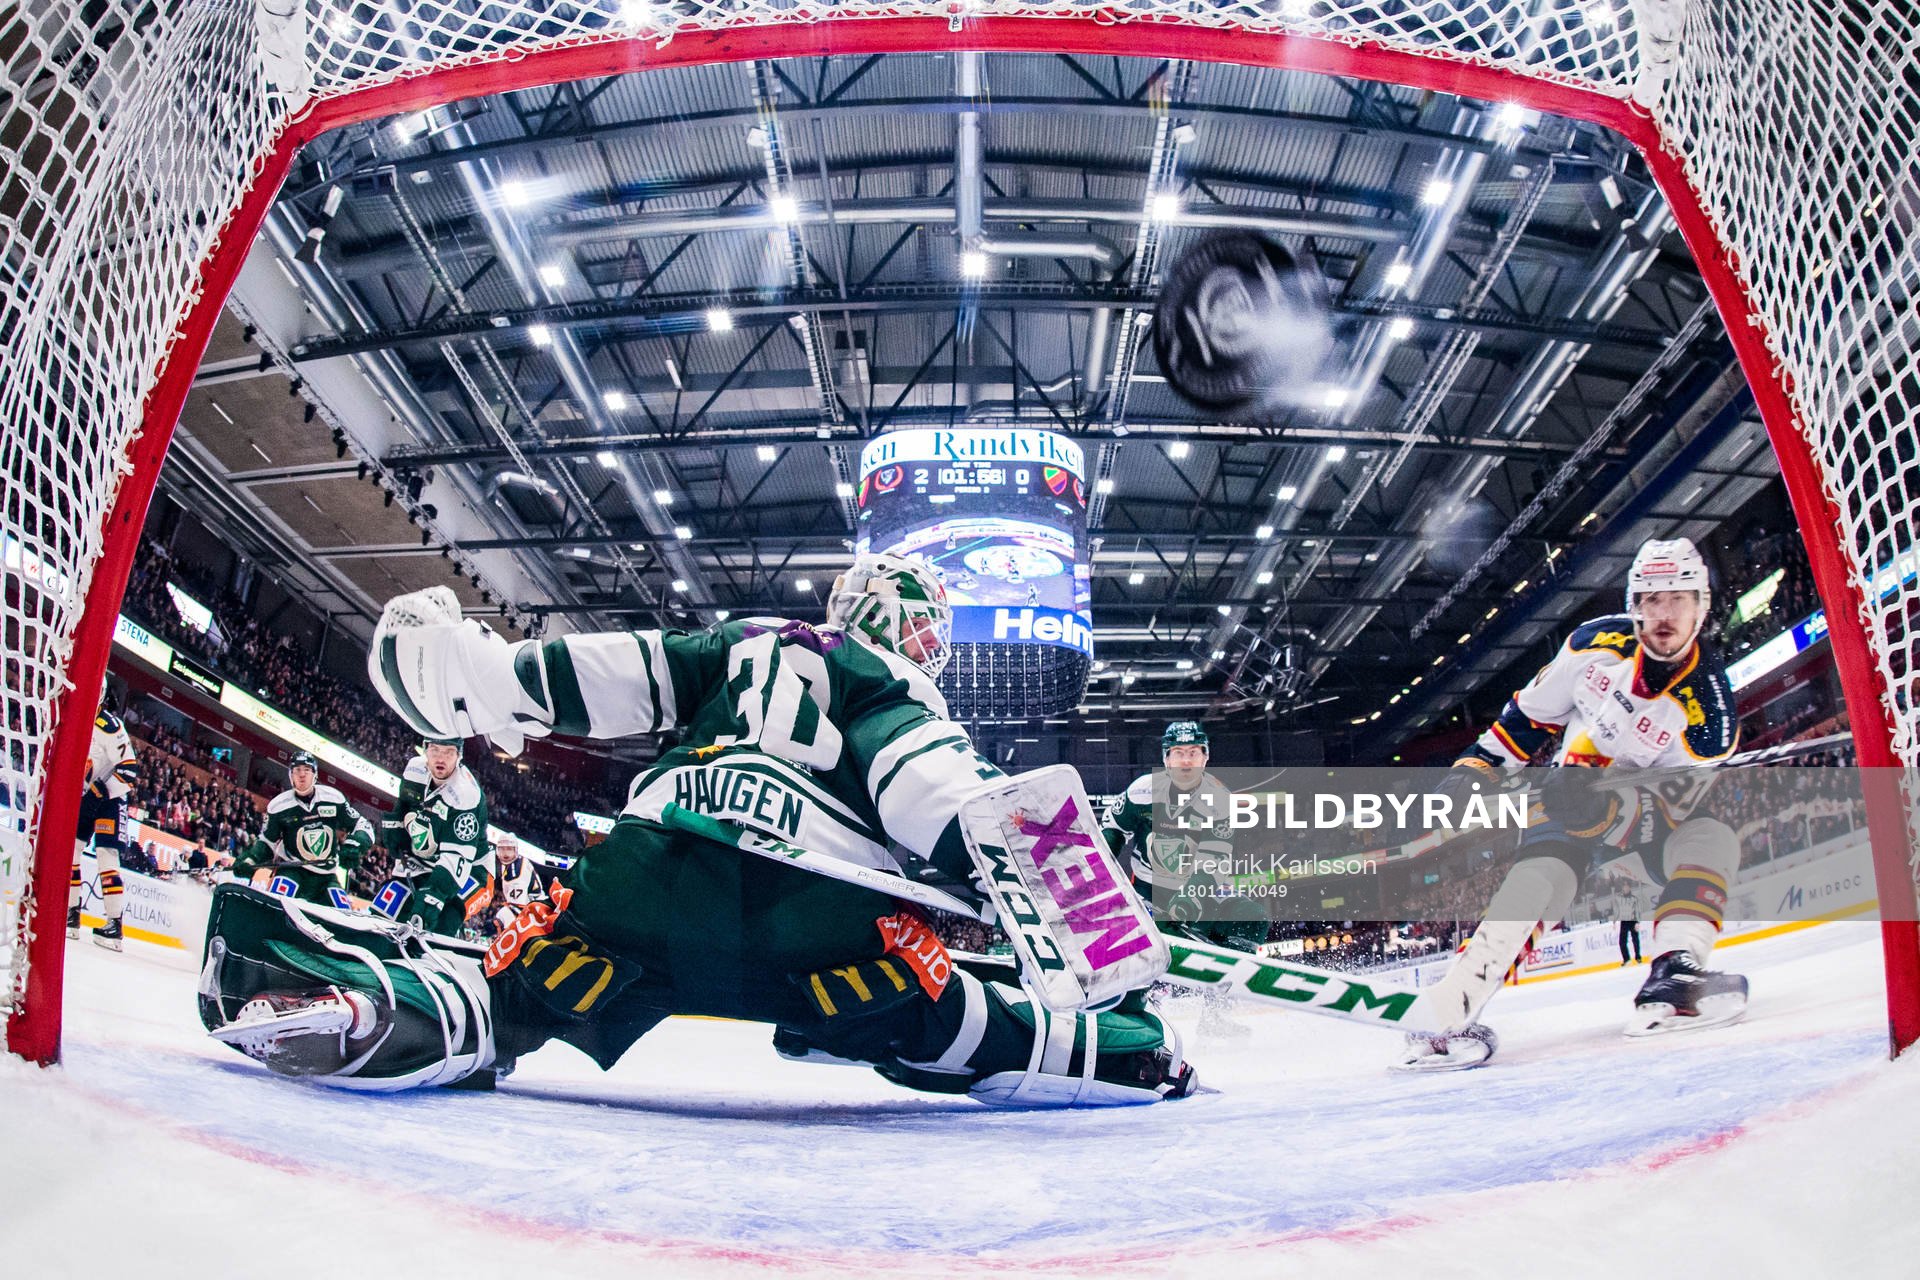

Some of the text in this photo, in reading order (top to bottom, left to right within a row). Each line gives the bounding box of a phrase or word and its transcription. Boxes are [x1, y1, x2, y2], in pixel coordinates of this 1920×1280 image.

[913, 469, 929, 485] 2
[1015, 469, 1030, 485] 0
[120, 619, 150, 648] STENA
[675, 767, 804, 839] HAUGEN
[509, 888, 524, 900] 47
[1809, 875, 1861, 900] MIDROC
[978, 842, 1066, 976] CCM
[1543, 941, 1574, 960] FRAKT
[1167, 944, 1419, 1022] CCM
